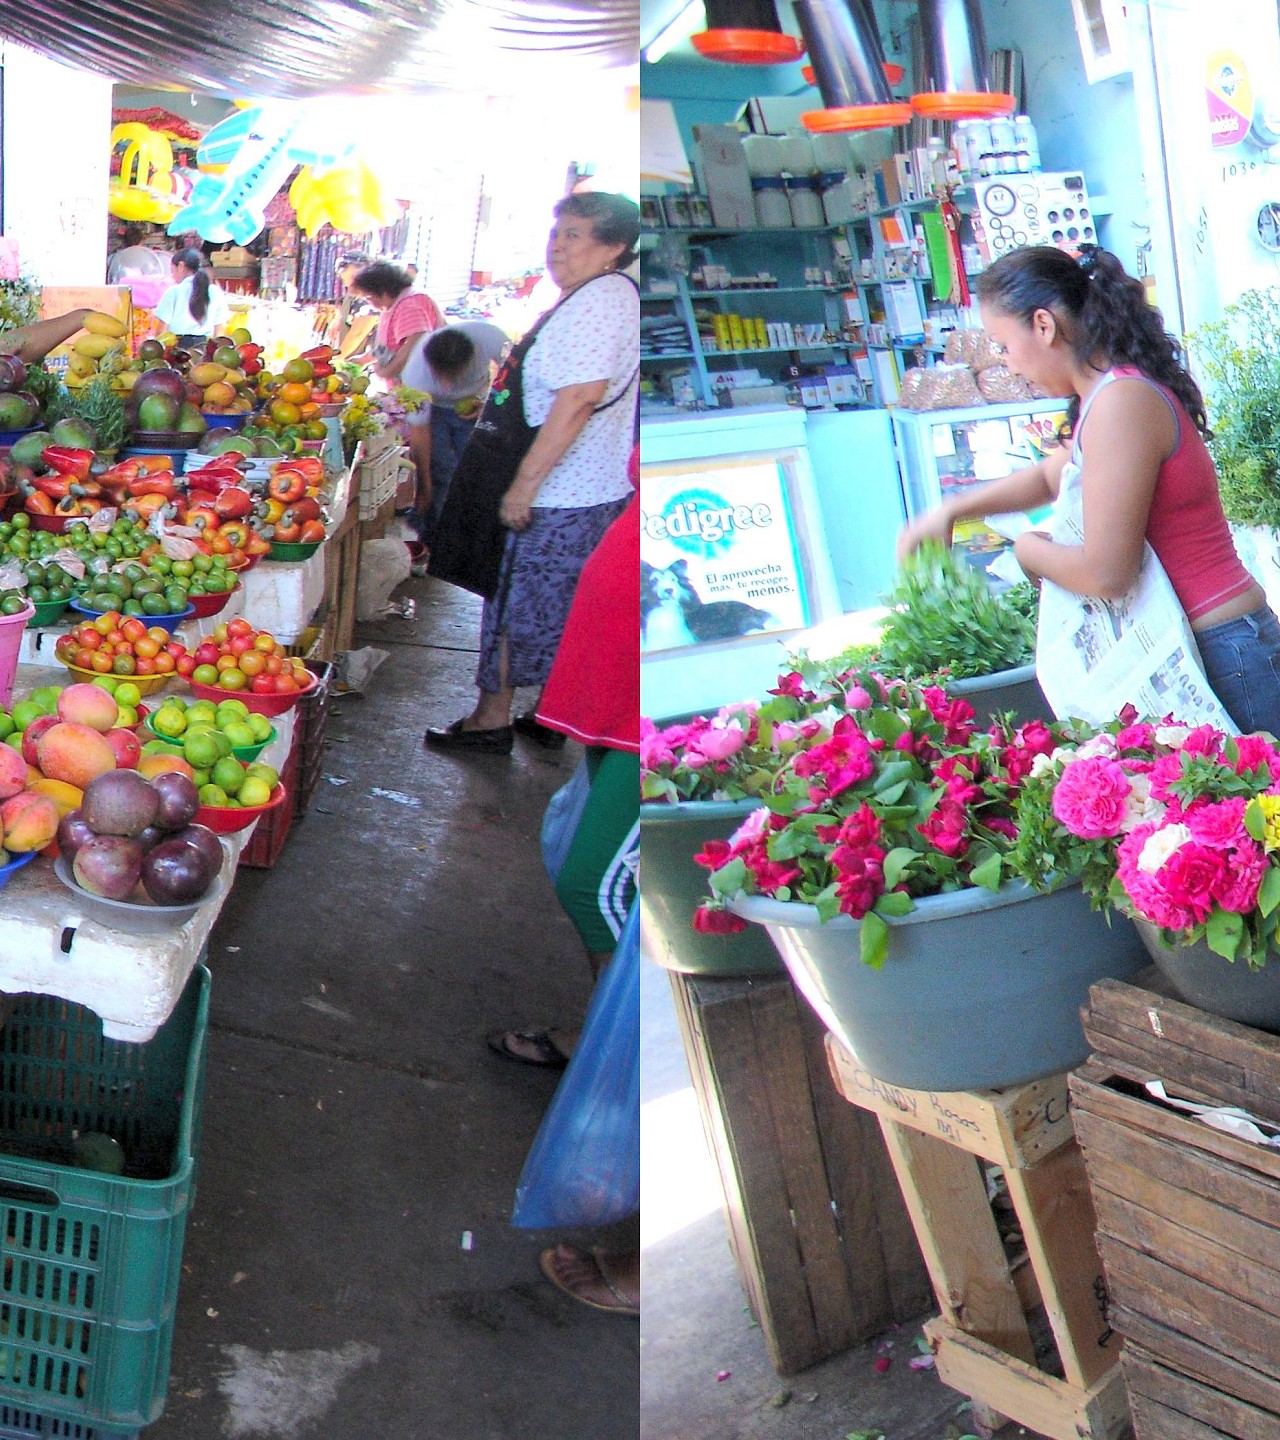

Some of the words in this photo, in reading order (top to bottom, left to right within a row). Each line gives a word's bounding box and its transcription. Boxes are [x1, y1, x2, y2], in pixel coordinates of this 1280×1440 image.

[1222, 161, 1257, 183] 1030
[706, 573, 717, 584] El
[721, 563, 782, 584] aprovecha
[747, 584, 795, 599] menos.
